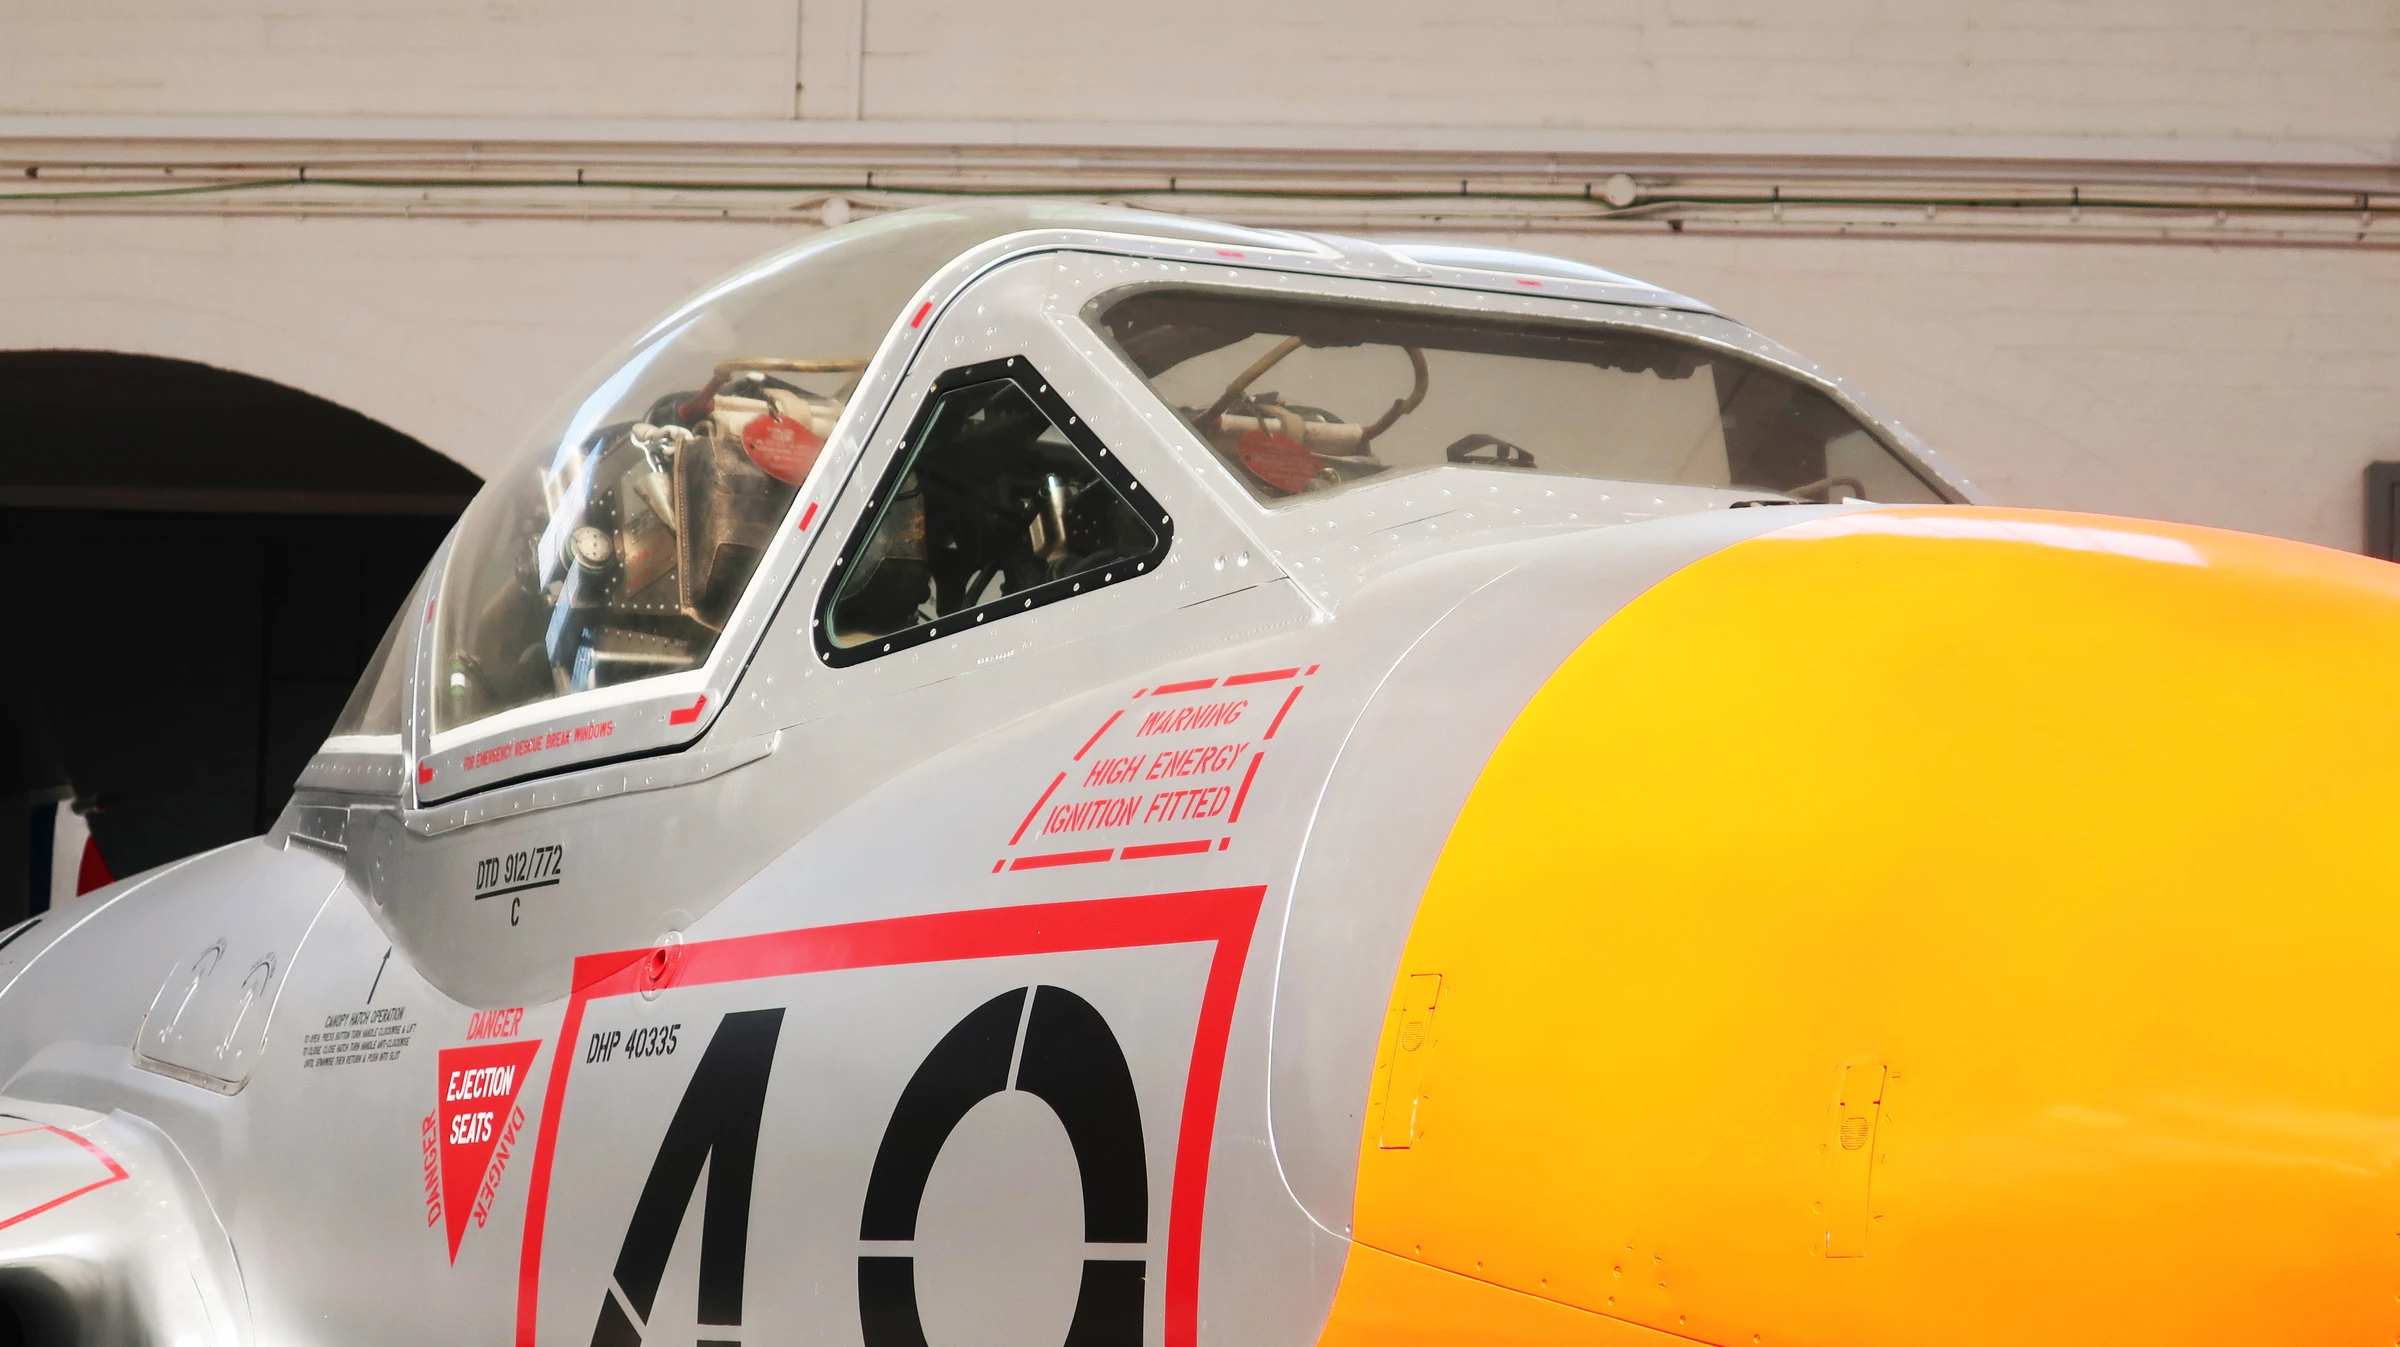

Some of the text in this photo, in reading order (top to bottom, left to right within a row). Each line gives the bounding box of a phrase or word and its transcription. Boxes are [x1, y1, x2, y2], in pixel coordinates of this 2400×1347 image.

[1136, 700, 1248, 737] WARNING
[464, 720, 614, 770] FOR EMERGENCY RESCUE BREAK WINDOWS
[1083, 742, 1250, 788] HIGH ENERGY
[1042, 785, 1231, 835] IGNITION FITTED
[476, 845, 563, 890] DTD 912/772
[511, 897, 520, 926] C
[325, 1007, 405, 1028] CANOPY HATCH OPERATION
[406, 1023, 417, 1033] LIFT
[466, 1007, 524, 1041] DANGER
[587, 1024, 681, 1064] DHP 40335
[446, 1065, 516, 1102] EJECTION
[450, 1111, 494, 1145] SEATS
[421, 1107, 442, 1228] DANGER
[472, 1105, 525, 1229] DANGER
